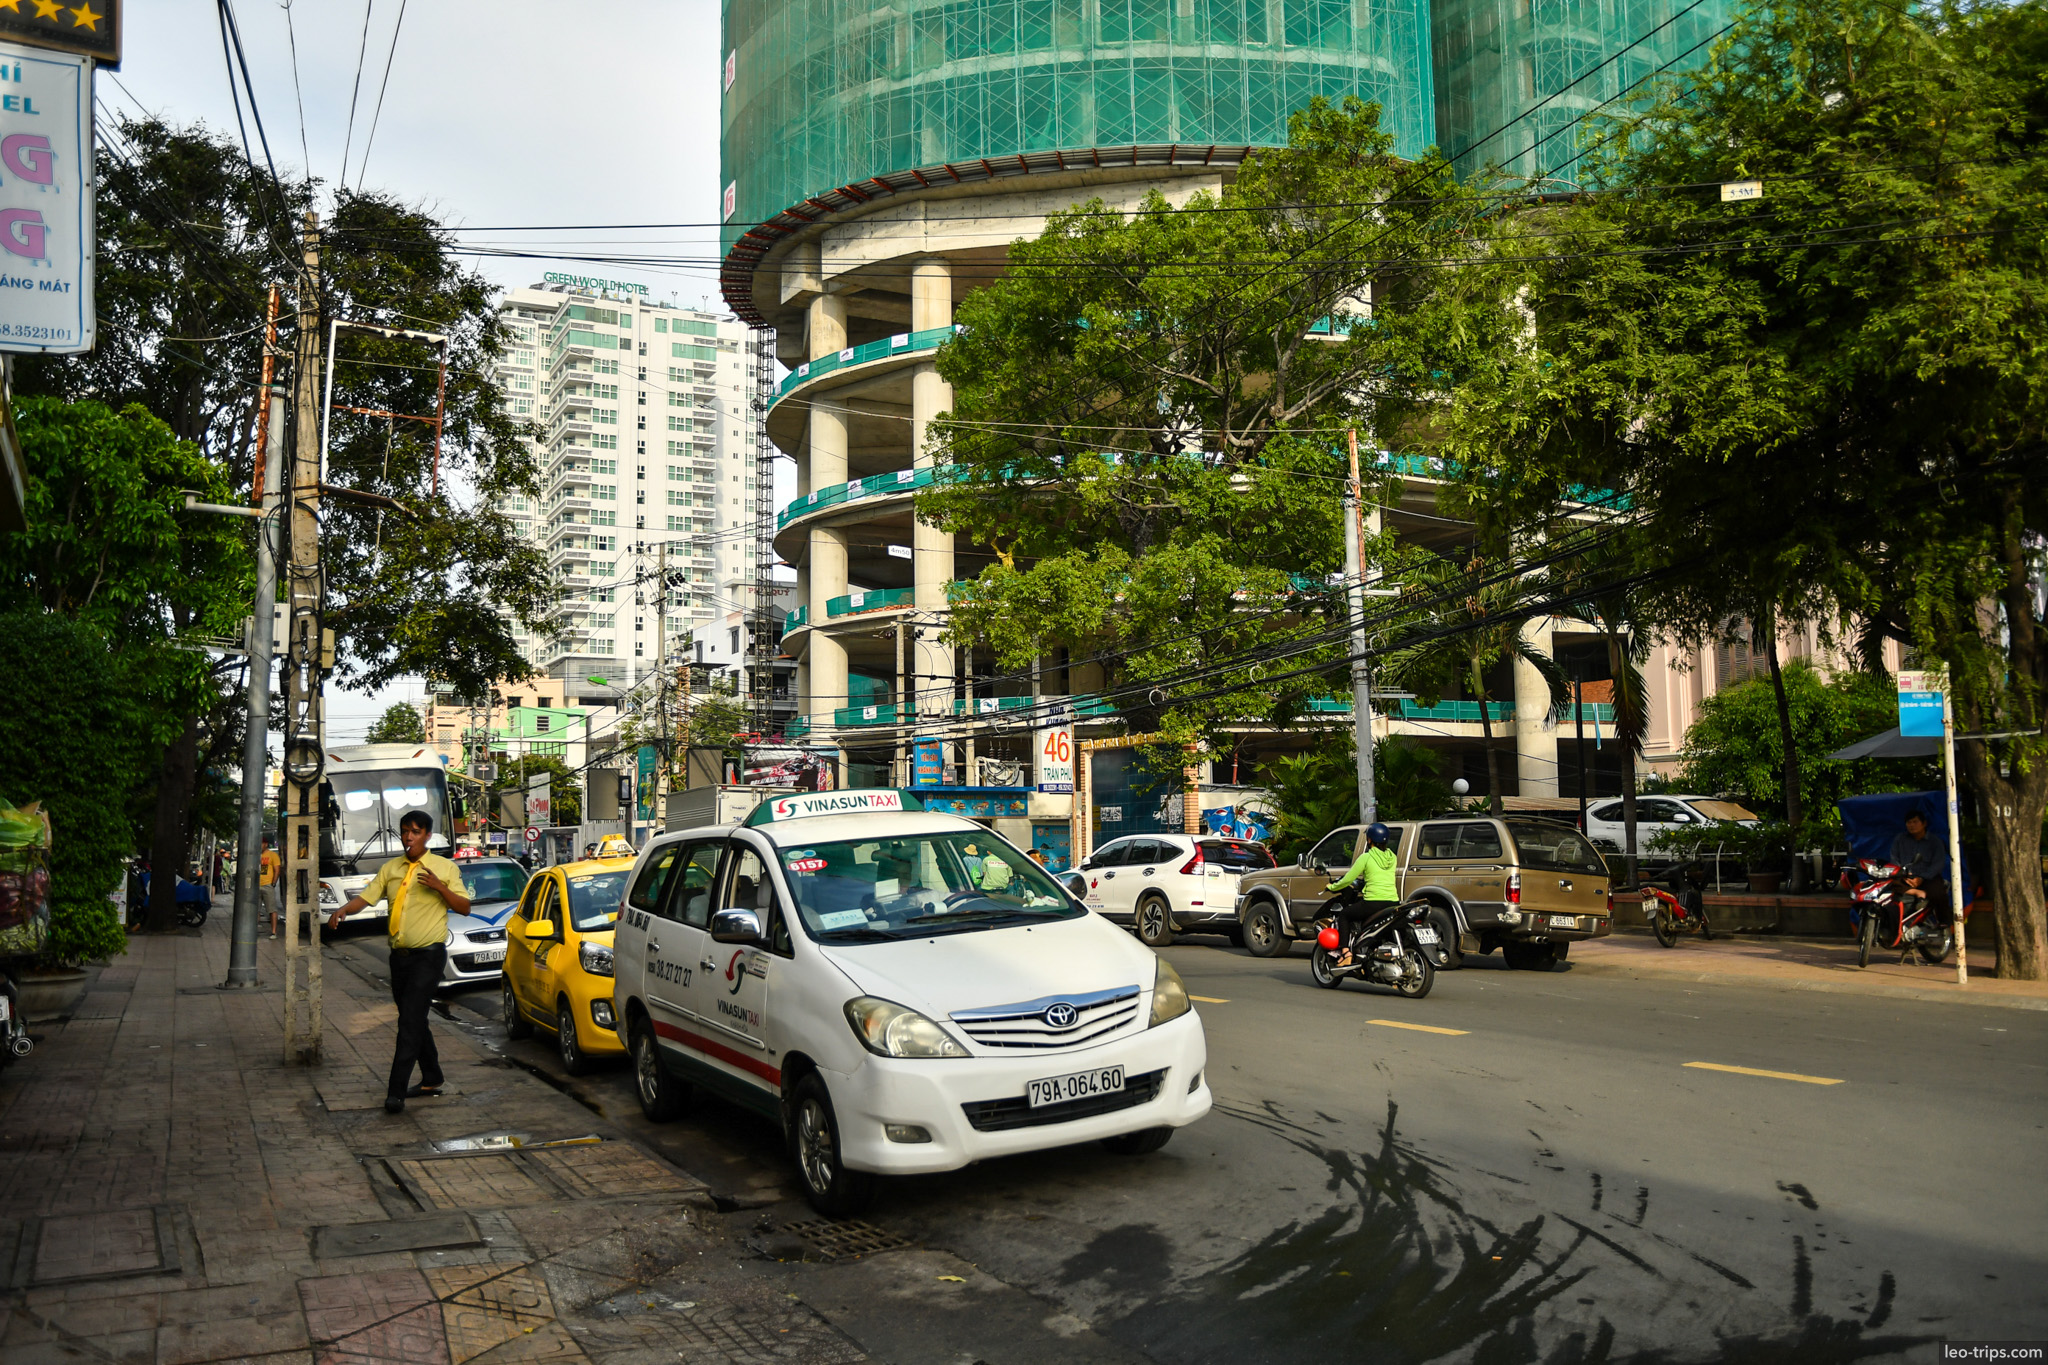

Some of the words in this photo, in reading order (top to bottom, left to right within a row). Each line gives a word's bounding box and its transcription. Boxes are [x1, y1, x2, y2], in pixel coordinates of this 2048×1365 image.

[39, 279, 71, 294] MÁT
[544, 272, 577, 286] GREEN
[578, 276, 616, 291] WORLD
[619, 282, 649, 296] HOTEL
[0, 323, 72, 341] 8.3523101
[891, 546, 910, 556] 4m50
[1044, 731, 1070, 762] 46
[790, 859, 823, 871] 6157
[674, 965, 683, 985] 27
[683, 968, 692, 988] 27
